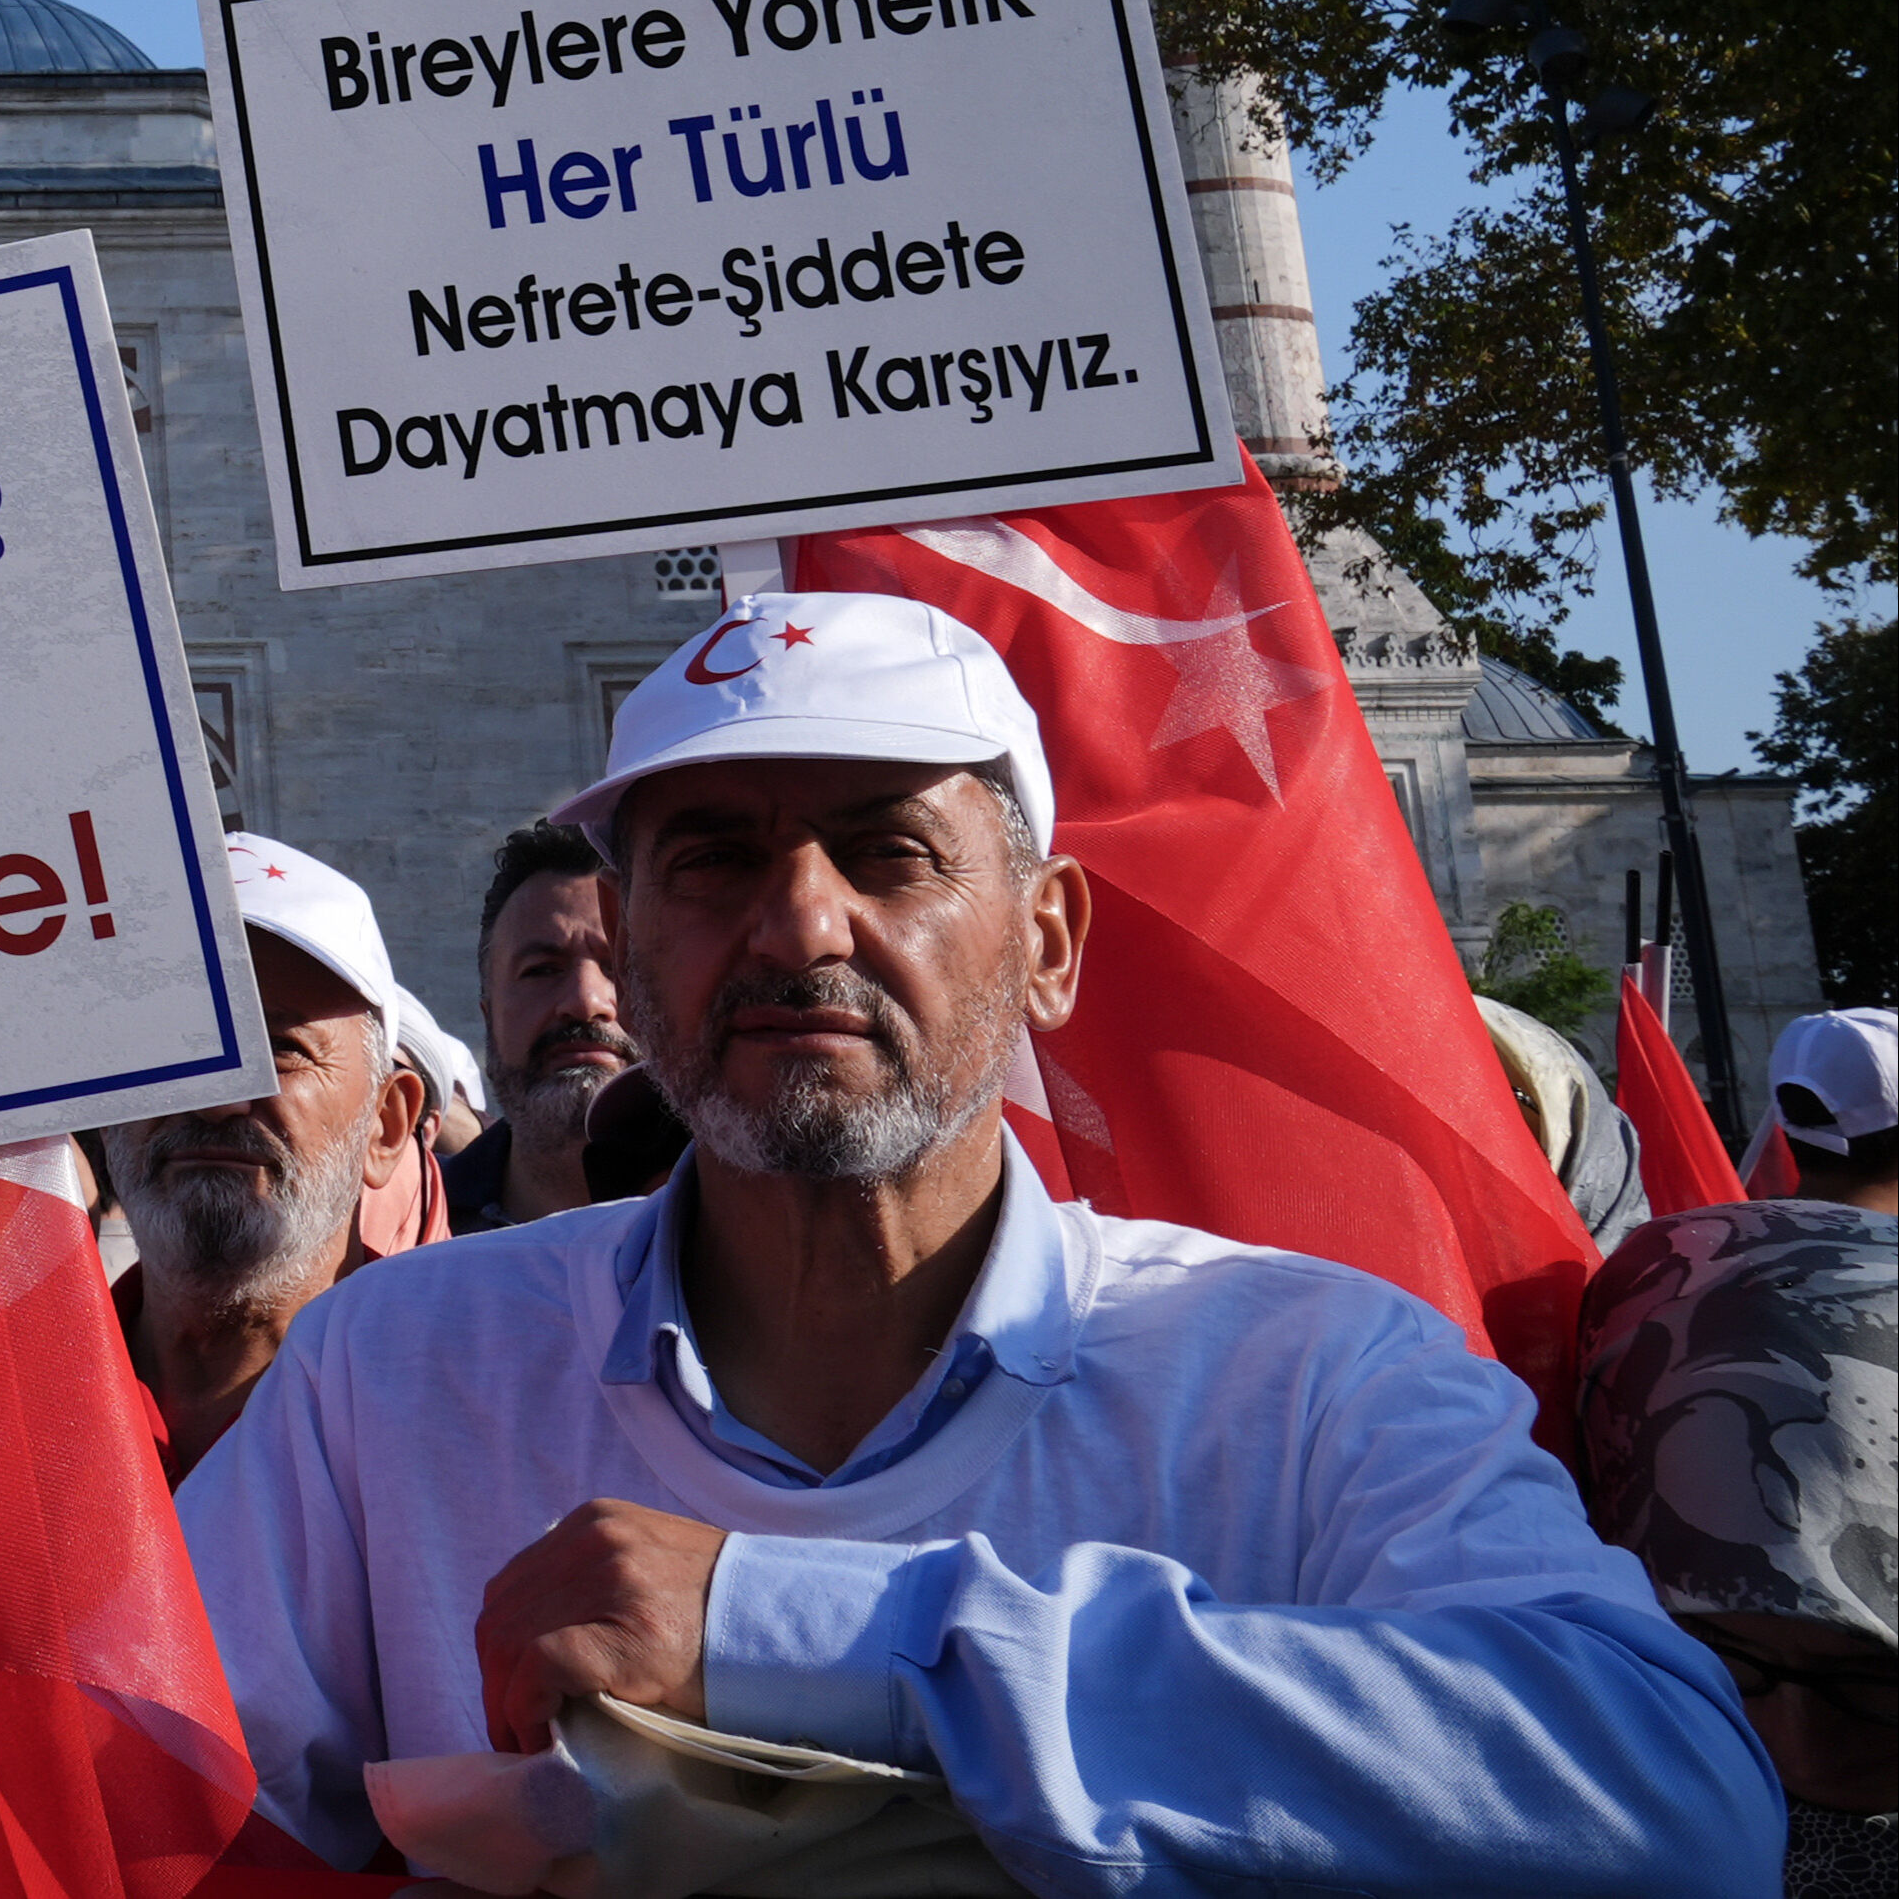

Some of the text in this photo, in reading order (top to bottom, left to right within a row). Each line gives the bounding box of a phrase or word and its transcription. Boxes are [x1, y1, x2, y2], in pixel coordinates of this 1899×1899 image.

[319, 9, 687, 112] Bireylere
[477, 87, 910, 230] Her Türlü
[407, 220, 1026, 357] Nefrete-Şiddete
[335, 332, 1139, 480] Dayatmaya Karşıyız.
